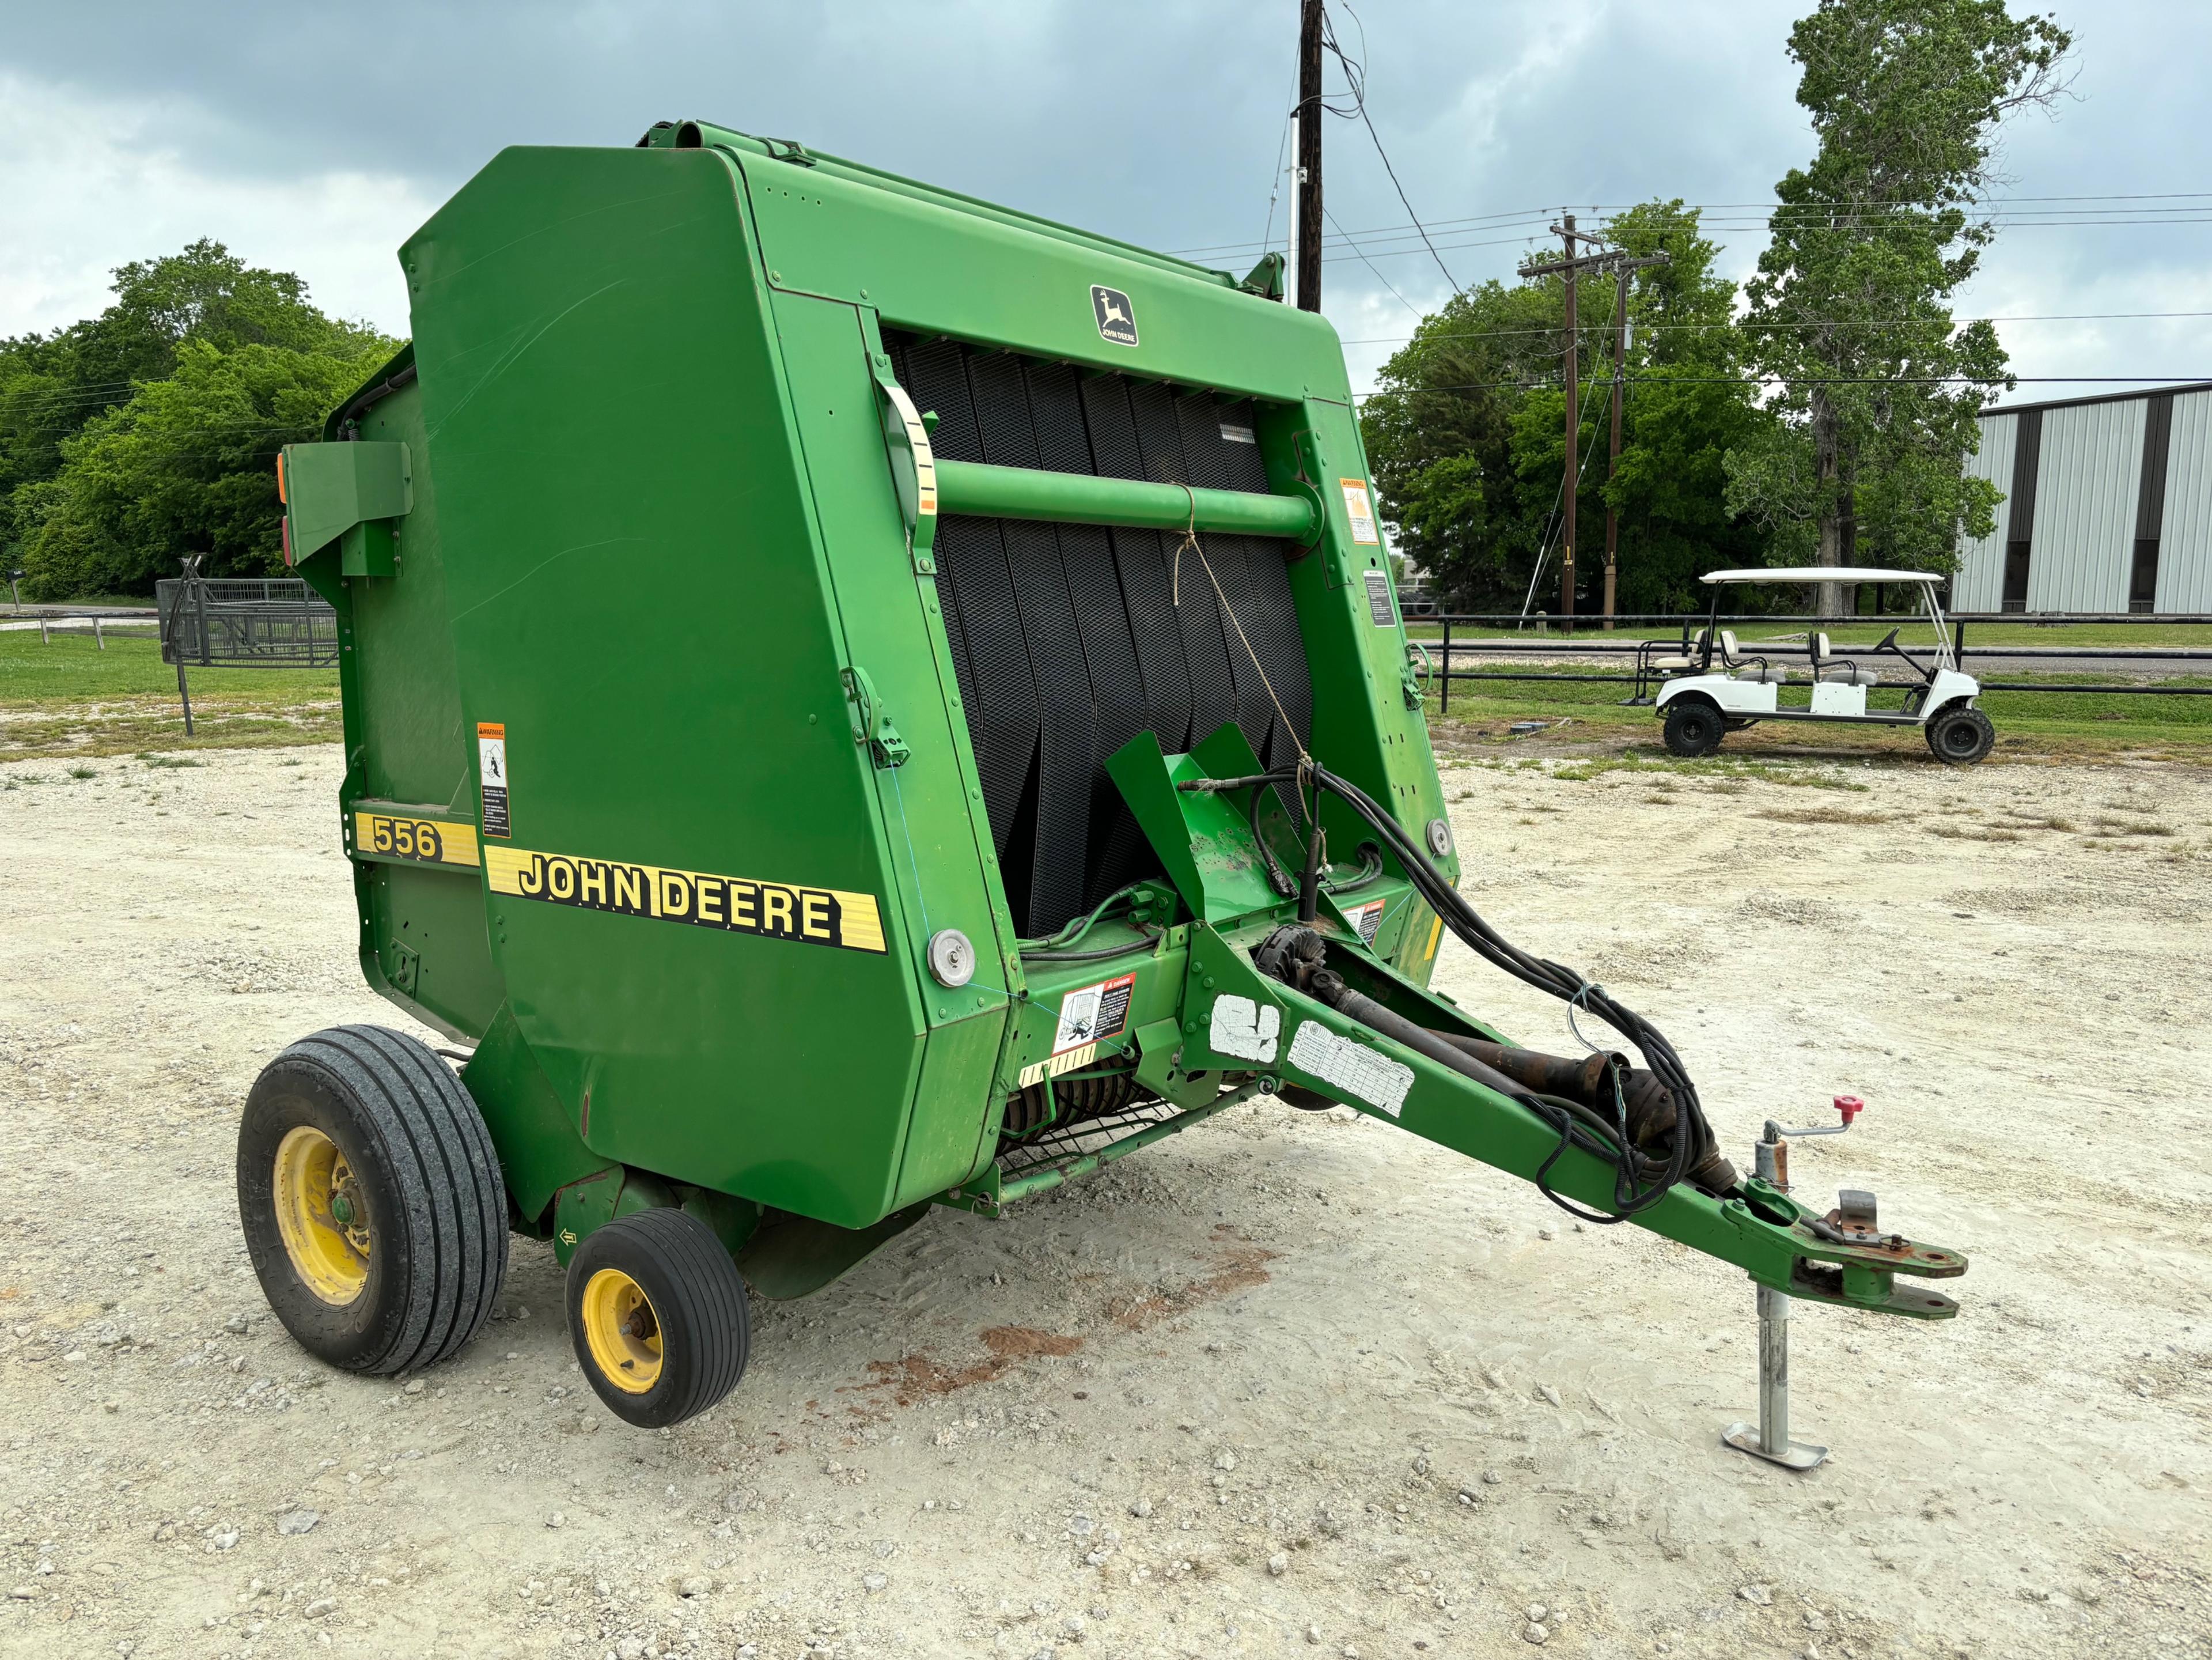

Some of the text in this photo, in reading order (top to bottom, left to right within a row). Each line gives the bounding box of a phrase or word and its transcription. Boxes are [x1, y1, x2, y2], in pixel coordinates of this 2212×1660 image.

[1103, 328, 1135, 342] JOHN DEERE
[373, 818, 439, 859] 556
[519, 855, 834, 940] JOHN DEERE
[1113, 978, 1130, 986] DANGER
